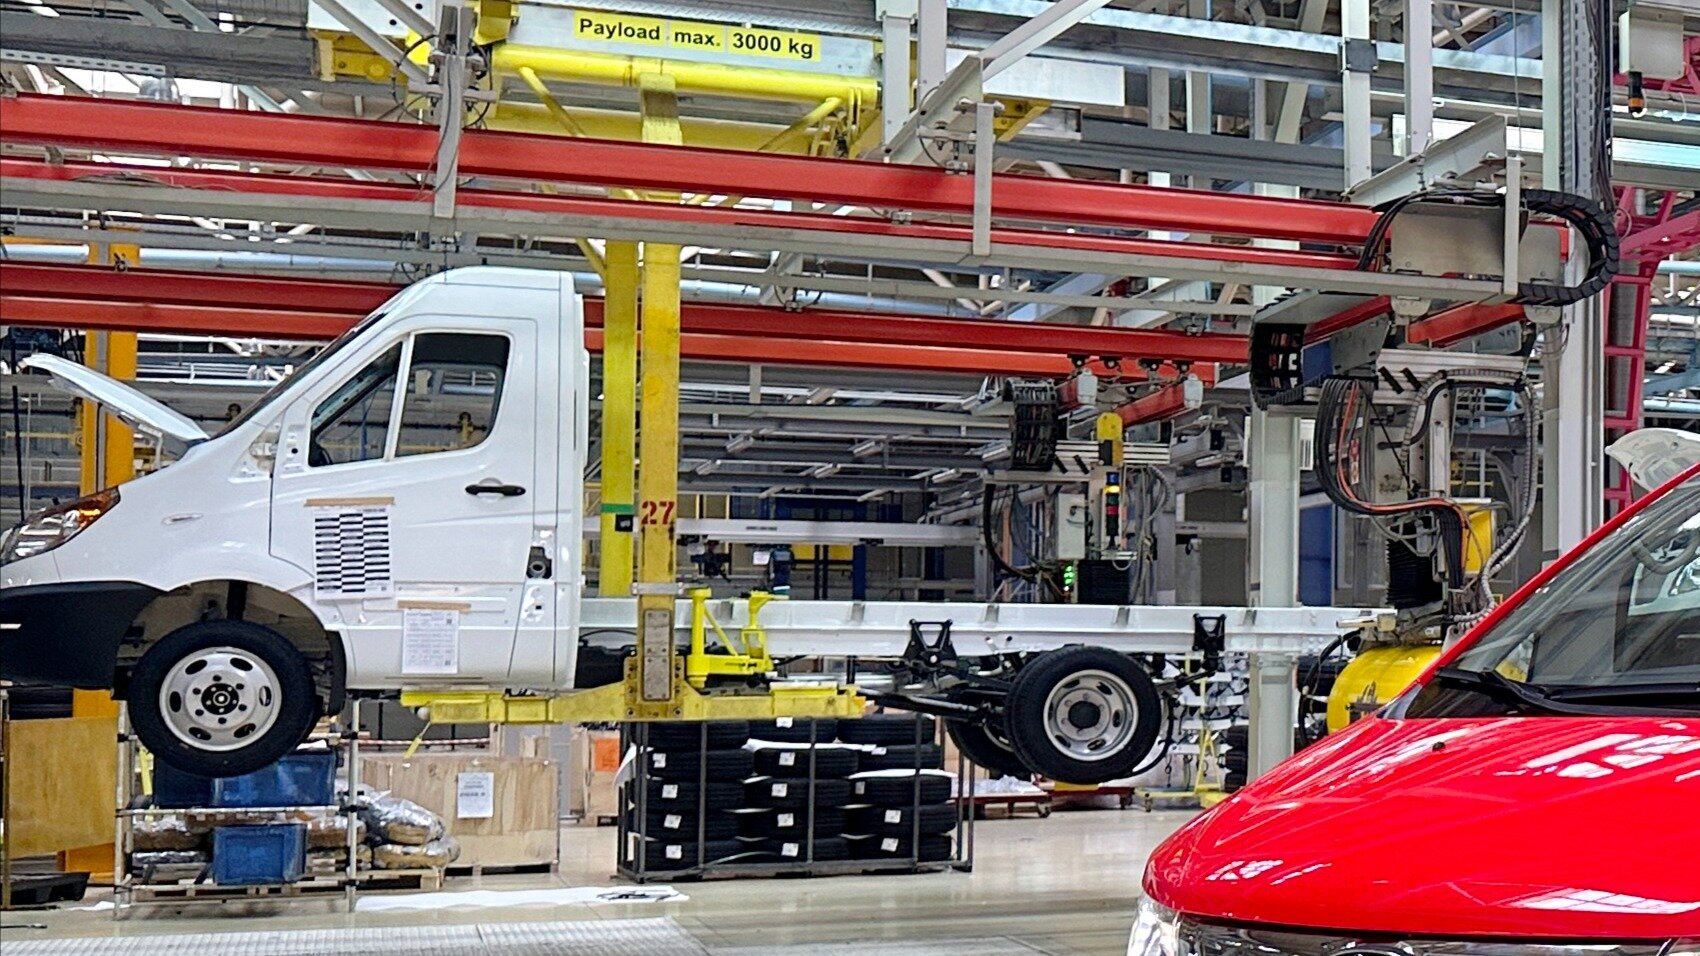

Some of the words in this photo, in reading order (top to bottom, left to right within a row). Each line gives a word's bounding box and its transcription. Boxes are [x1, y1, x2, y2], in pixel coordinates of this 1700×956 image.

[579, 17, 660, 40] Payload
[674, 31, 721, 47] max.
[732, 32, 781, 52] 3000
[788, 38, 814, 59] kg
[641, 500, 675, 525] 27
